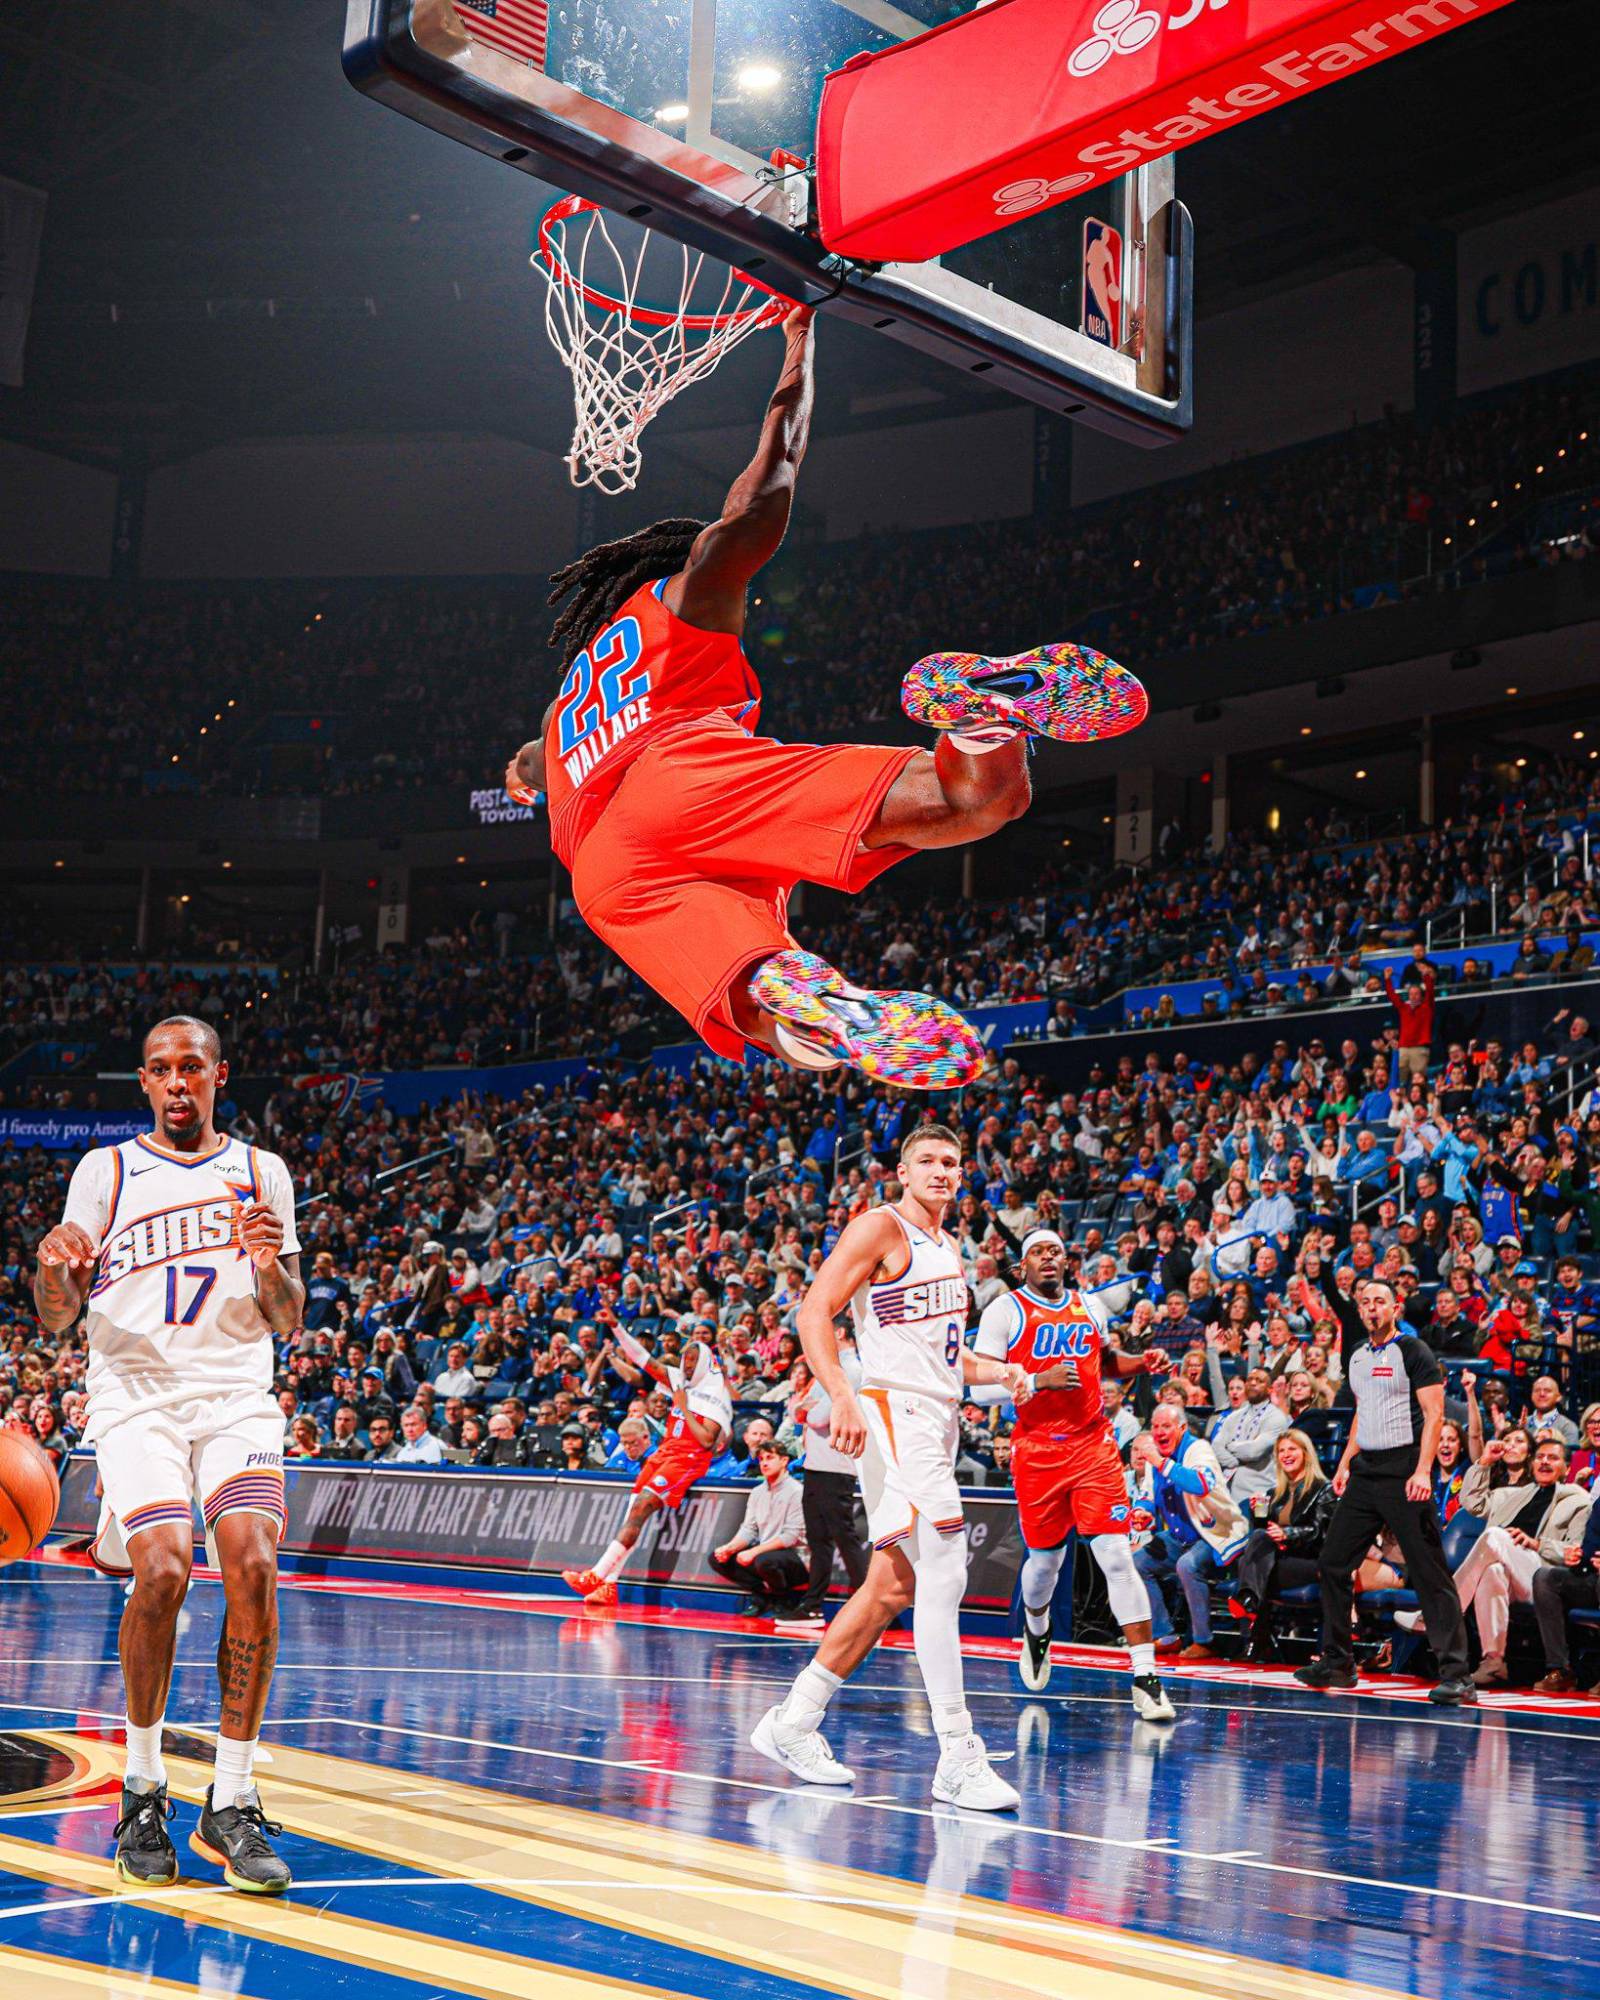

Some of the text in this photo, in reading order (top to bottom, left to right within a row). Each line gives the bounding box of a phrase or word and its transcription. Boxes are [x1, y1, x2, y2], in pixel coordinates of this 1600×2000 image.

[1087, 313, 1107, 340] NBA
[1416, 303, 1432, 368] 322
[558, 615, 652, 757] 22
[563, 697, 652, 790] WALLACE
[480, 806, 535, 823] TOYOTA
[1129, 794, 1139, 852] 221
[9, 1118, 61, 1141] fiercely
[63, 1123, 90, 1141] pro
[91, 1120, 150, 1137] American
[107, 1202, 233, 1282] SUNS
[164, 1265, 219, 1327] 17
[903, 1277, 969, 1323] SUNS
[945, 1322, 960, 1368] 8
[1031, 1321, 1095, 1359] OKC
[304, 1479, 724, 1554] WITH KEVIN HART & KENAN THPSON
